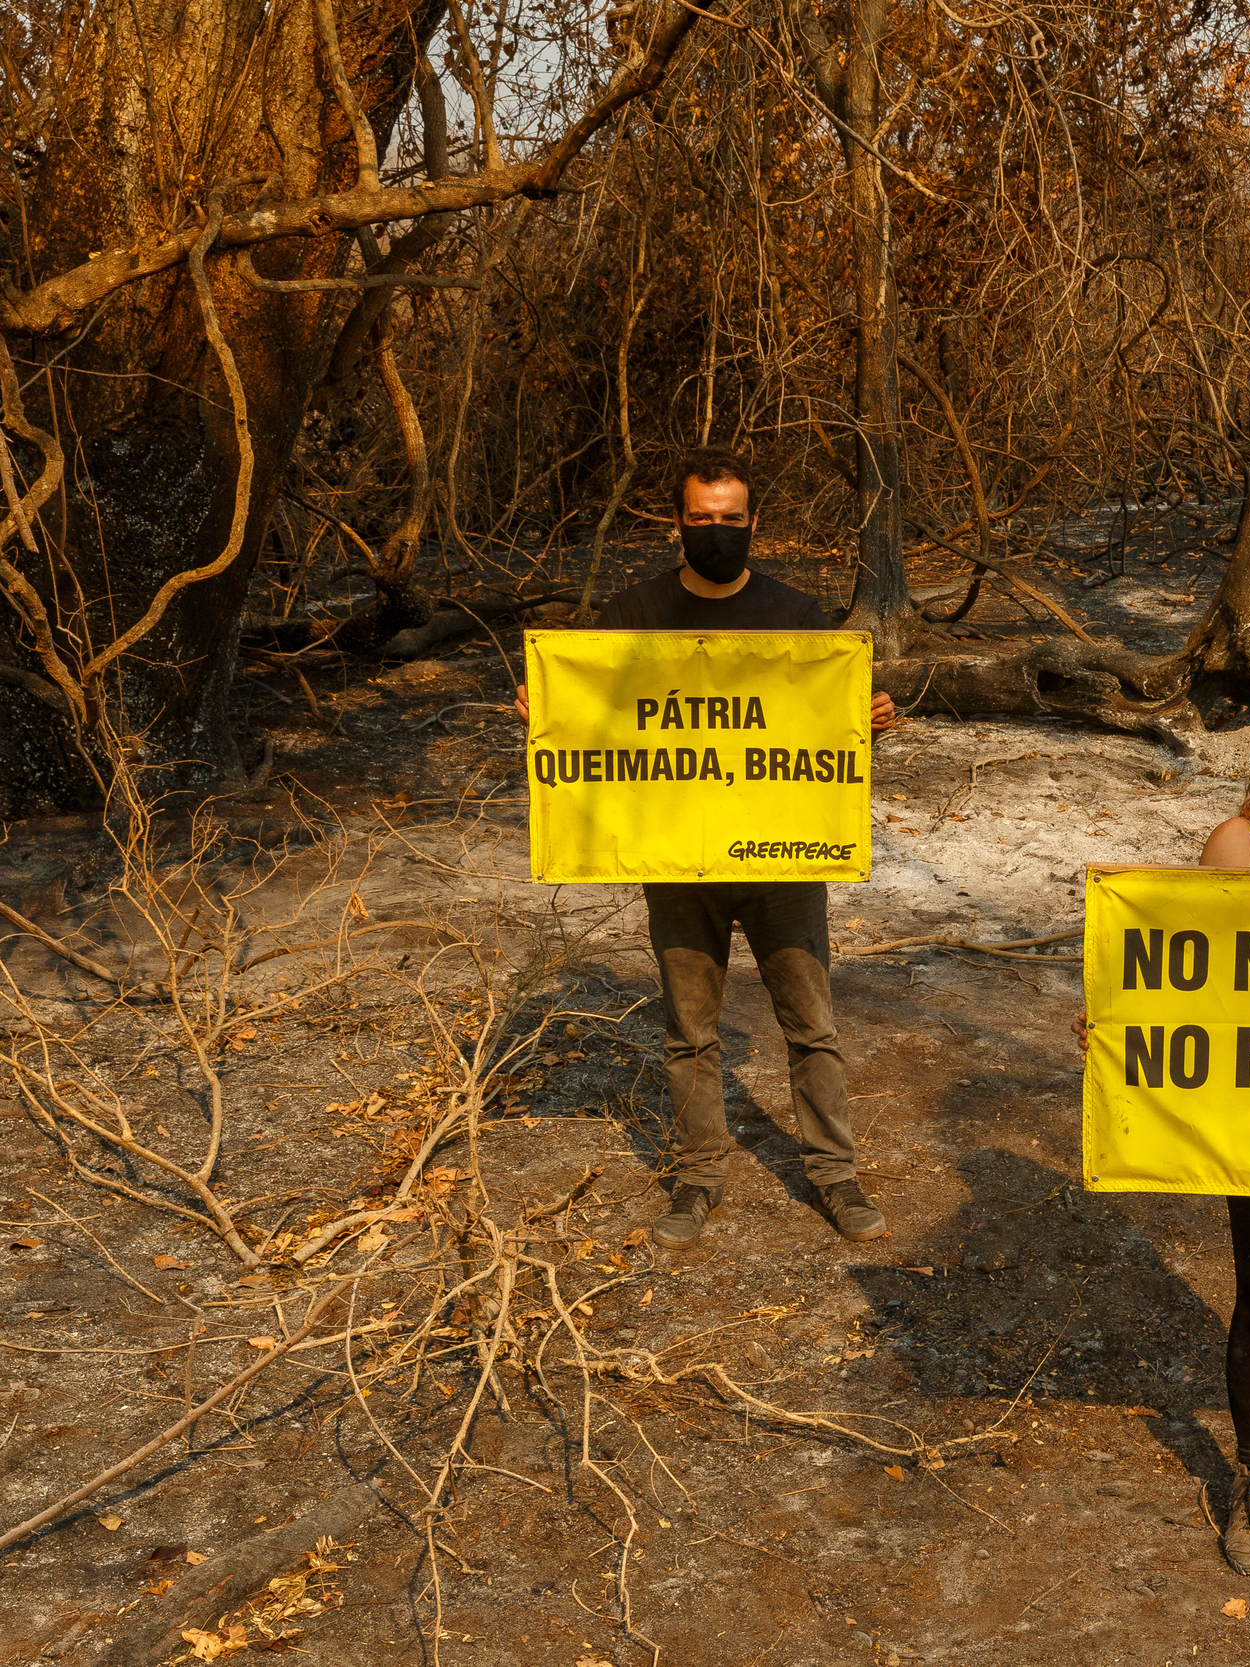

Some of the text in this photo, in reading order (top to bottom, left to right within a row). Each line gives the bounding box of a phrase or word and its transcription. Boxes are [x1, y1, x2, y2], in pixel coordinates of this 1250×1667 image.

[637, 689, 767, 731] PÁTRIA
[534, 748, 864, 788] QUEIMADA, BRASIL
[728, 840, 857, 861] GREENPEACE
[1123, 928, 1210, 991] NO
[1125, 1025, 1210, 1090] NO
